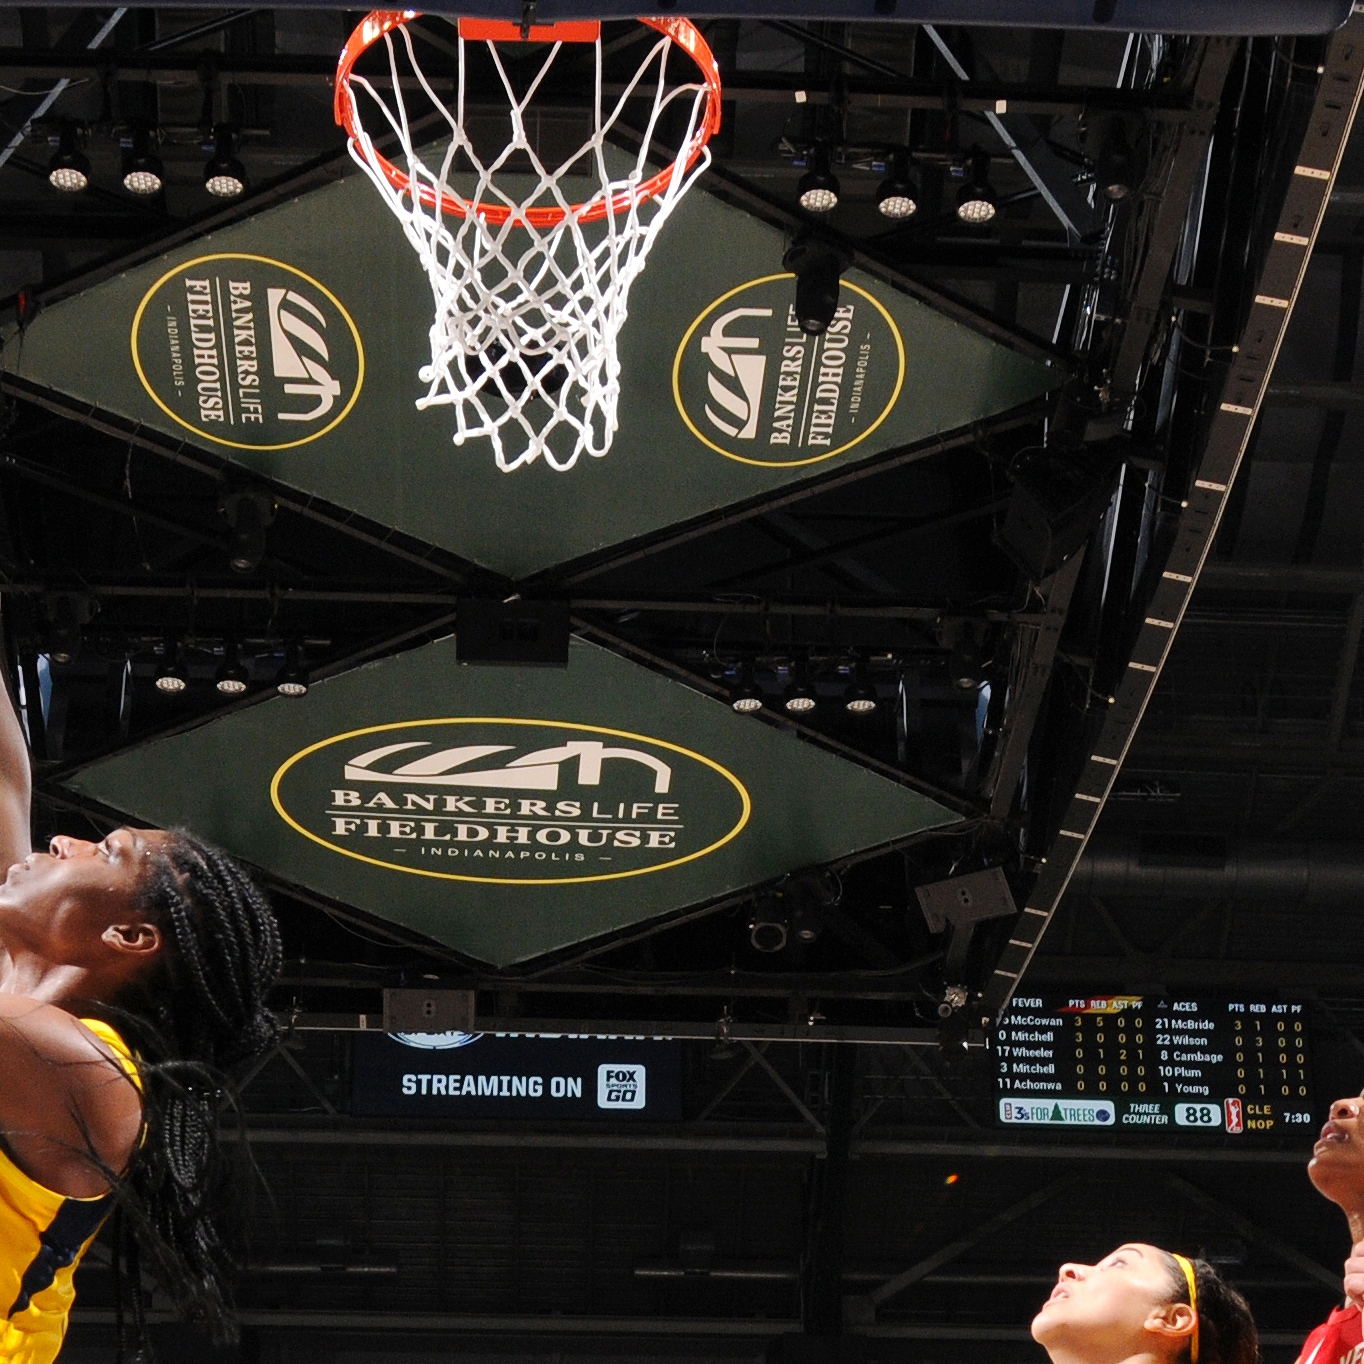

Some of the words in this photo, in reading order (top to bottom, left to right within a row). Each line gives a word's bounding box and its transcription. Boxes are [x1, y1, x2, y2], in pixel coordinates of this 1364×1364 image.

[167, 316, 185, 386] INDIANAPOLIS
[186, 278, 224, 422] FIELDHOUSE
[808, 304, 854, 446] FIELDHOUSE
[848, 344, 870, 423] INDIANAPOLIS
[331, 817, 676, 848] FIELDHOUSE
[421, 846, 586, 862] INDIANAPOLIS
[1012, 998, 1042, 1008] FEVER
[1068, 1000, 1085, 1008] PTS
[1090, 1000, 1107, 1008] REB
[1112, 1000, 1128, 1008] AST
[1172, 1002, 1198, 1012] ACES
[1228, 1004, 1244, 1012] PTS
[1250, 1004, 1266, 1012] REB
[1271, 1004, 1288, 1013] AST
[1291, 1005, 1302, 1014] PF
[1010, 1016, 1062, 1026] McCowan
[1155, 1018, 1168, 1029] 21
[1172, 1019, 1214, 1030] McBride
[998, 1030, 1006, 1040] 0
[1012, 1031, 1054, 1042] Mitchell
[1156, 1034, 1170, 1046] 22
[1172, 1035, 1208, 1046] Wilson
[996, 1046, 1010, 1056] 17
[1012, 1047, 1054, 1058] Wheeler
[1160, 1050, 1168, 1060] 8
[1174, 1051, 1223, 1064] Cambage
[1000, 1062, 1008, 1073] 3
[1012, 1063, 1054, 1074] Mitchell
[1159, 1066, 1172, 1076] 10
[1174, 1066, 1202, 1077] Plum
[606, 1070, 638, 1083] FOX
[402, 1074, 543, 1098] STREAMING
[550, 1076, 582, 1098] ON
[998, 1078, 1010, 1089] 11
[1014, 1080, 1062, 1090] Achonwa
[1175, 1083, 1209, 1096] Young
[1299, 1086, 1306, 1096] 0
[606, 1089, 636, 1102] GO
[1031, 1107, 1050, 1120] FOR
[1064, 1108, 1094, 1122] TREES
[1130, 1104, 1160, 1114] THREE
[1247, 1104, 1272, 1114] CLE
[1122, 1114, 1168, 1124] COUNTER
[1186, 1107, 1212, 1124] 88
[1284, 1112, 1310, 1124] 7:30
[1247, 1120, 1274, 1130] NOP
